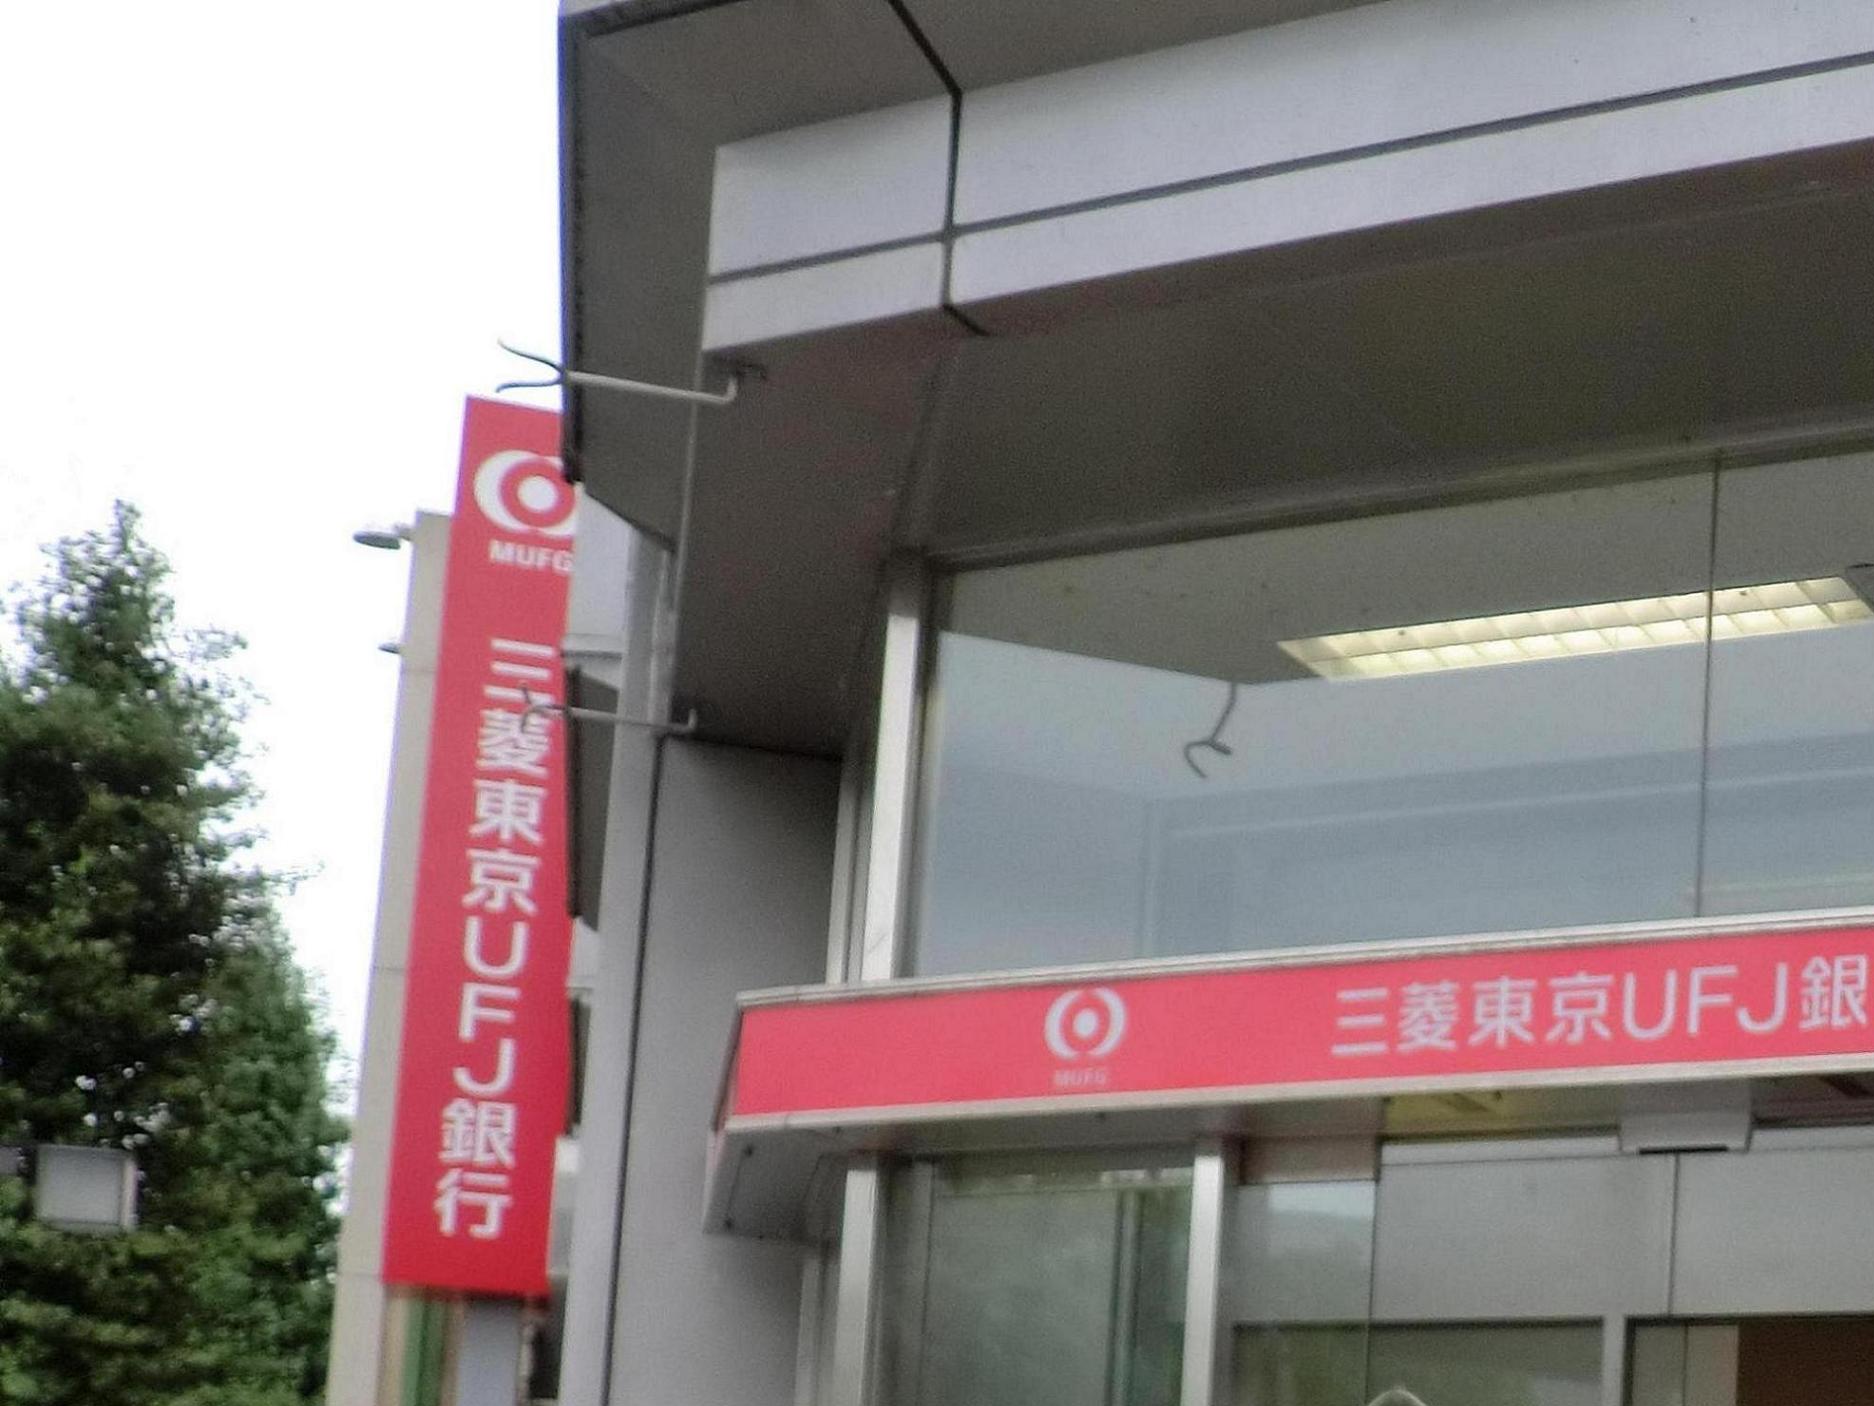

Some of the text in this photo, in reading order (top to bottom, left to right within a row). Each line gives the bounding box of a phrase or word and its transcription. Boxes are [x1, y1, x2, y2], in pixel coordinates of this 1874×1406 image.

[489, 538, 574, 575] MUFG
[433, 636, 555, 1242] 三菱東京UFJ銀行
